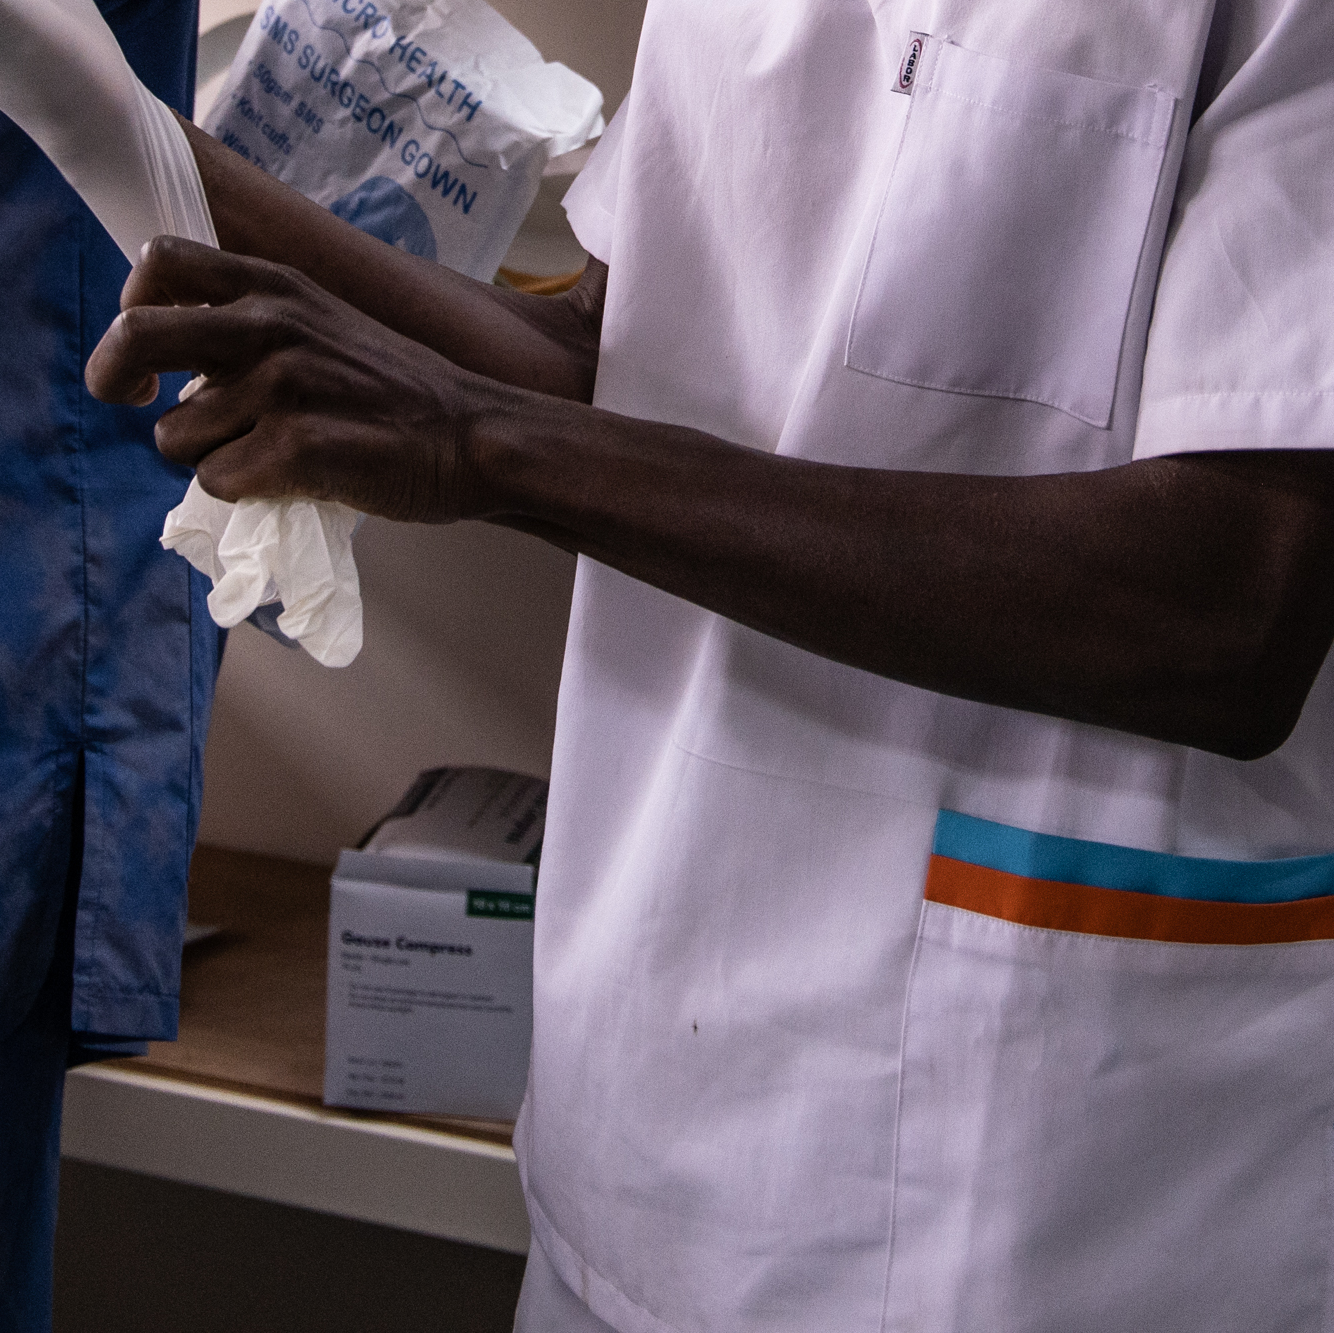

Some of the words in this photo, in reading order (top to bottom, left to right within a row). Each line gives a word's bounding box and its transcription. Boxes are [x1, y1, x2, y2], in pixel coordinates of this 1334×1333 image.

[389, 35, 483, 123] HEALTH
[902, 44, 919, 83] LABOR
[237, 96, 263, 128] Knit
[259, 4, 297, 55] SMS
[297, 43, 403, 149] SURGEON
[400, 138, 479, 215] GOWN
[295, 101, 325, 134] SMS
